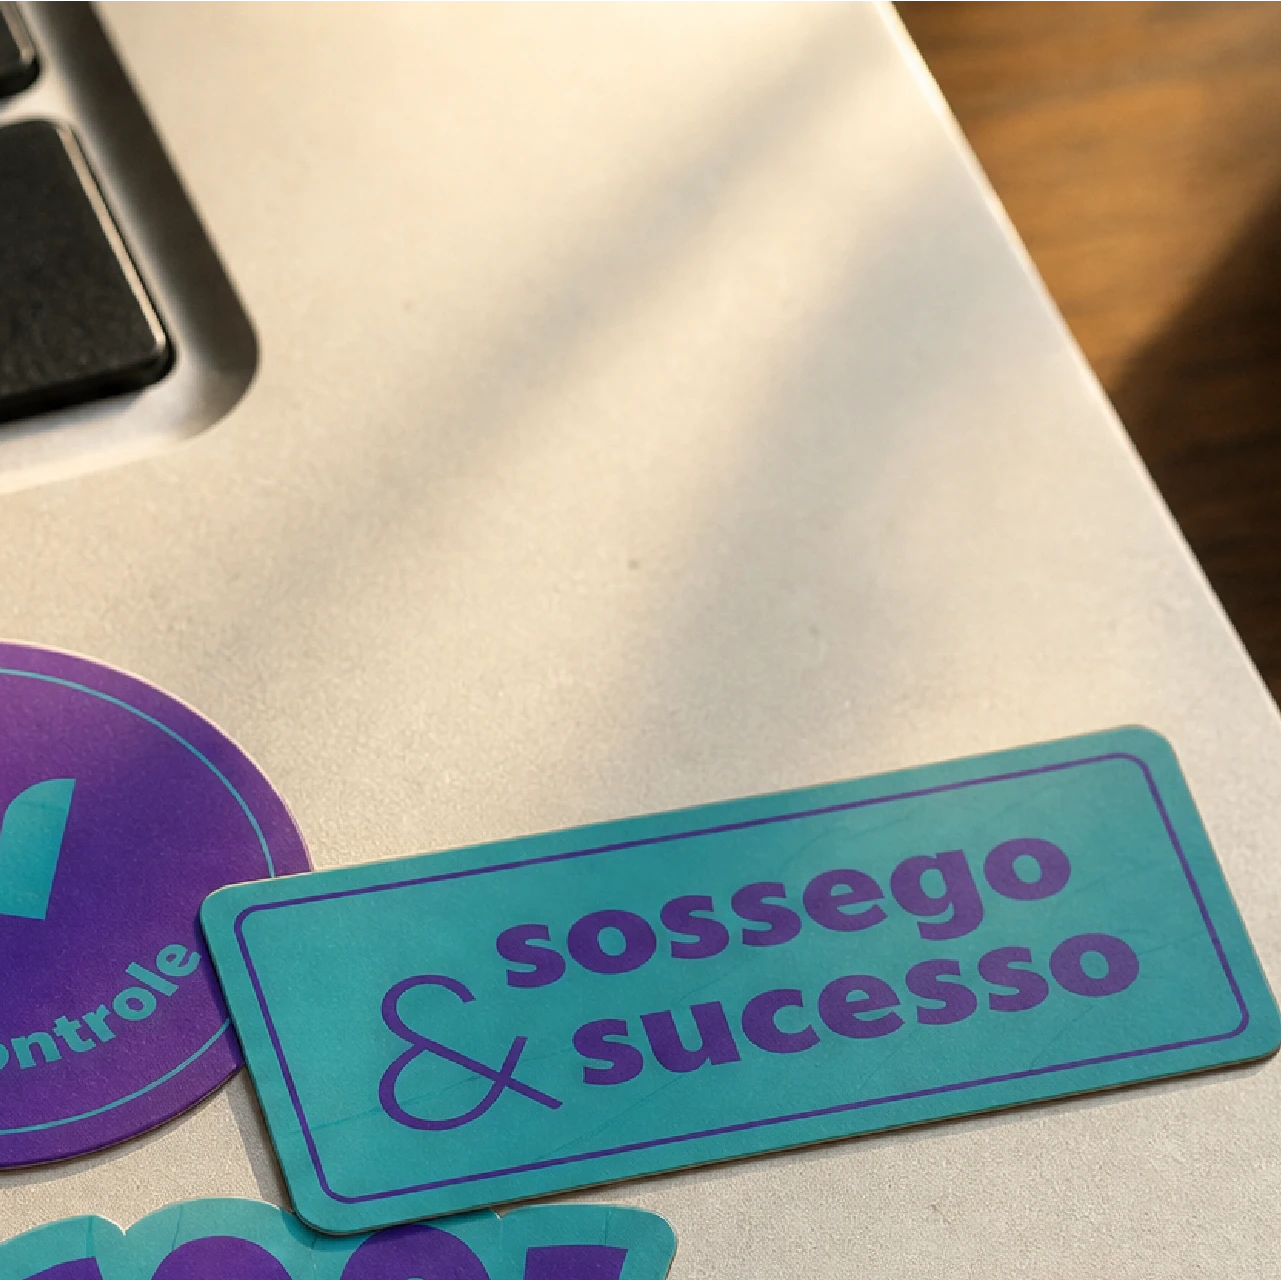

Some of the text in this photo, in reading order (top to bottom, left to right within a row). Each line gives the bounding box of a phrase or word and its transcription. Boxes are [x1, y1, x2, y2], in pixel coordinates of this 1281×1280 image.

[495, 837, 1072, 988] sossego
[378, 932, 1139, 1131] & sucesso
